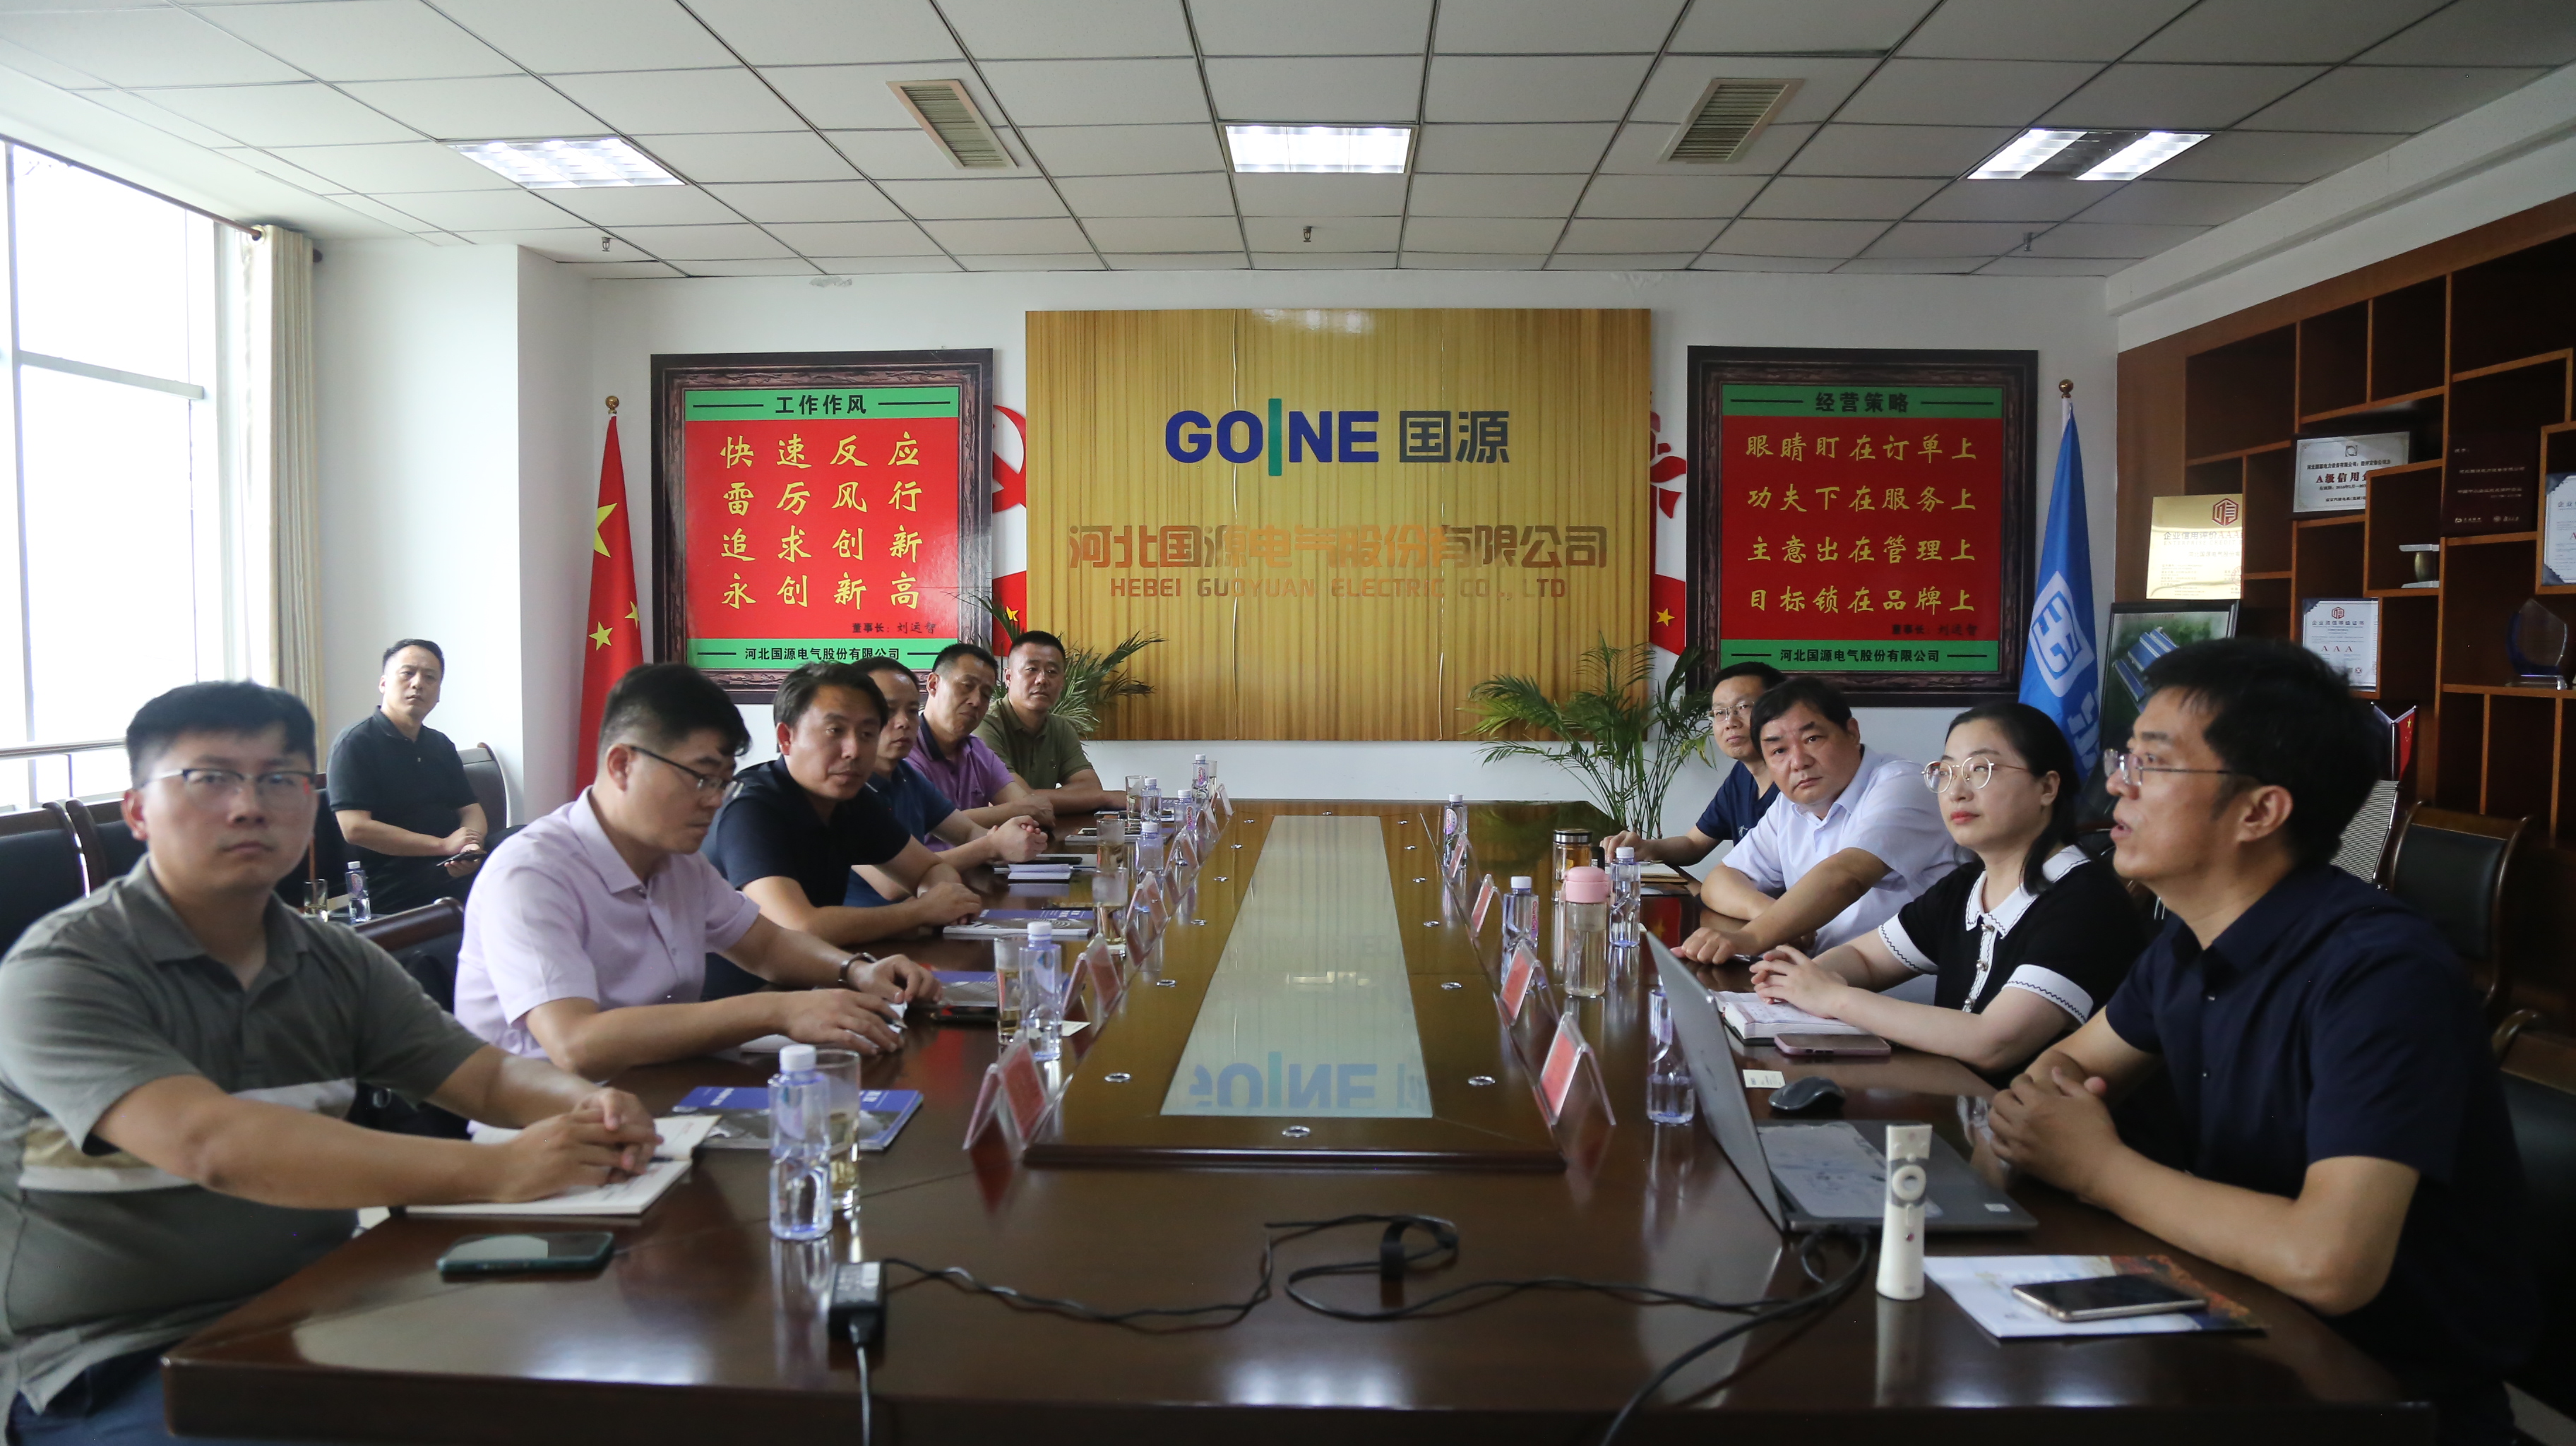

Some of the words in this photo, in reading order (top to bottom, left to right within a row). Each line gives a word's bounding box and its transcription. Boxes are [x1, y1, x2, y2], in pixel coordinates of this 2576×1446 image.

[775, 394, 867, 415] 工作作风
[1815, 391, 1909, 413] 经营策略
[720, 431, 919, 469] 快速反应
[1399, 410, 1510, 463] 国源
[1746, 432, 1976, 464] 眼睛盯在订单上
[723, 481, 922, 516] 雷厉风行
[1747, 483, 1976, 513] 功夫下在服务上
[722, 525, 923, 563] 追求创新
[1068, 524, 1608, 568] 河北国源电气股份有限公司
[1747, 534, 1975, 564] 主意出在管理上
[2163, 531, 2242, 540] 企业信用评价AAA
[722, 571, 919, 610] 永创新高
[1111, 578, 1180, 597] HEBEI
[1197, 578, 1315, 598] GUOYUAN
[1331, 578, 1445, 598] ELECTRIC
[1522, 578, 1566, 598] LTD
[1751, 585, 1974, 615] 目标锁在品牌上
[745, 647, 900, 661] 河北国源电气股份有限公司
[1780, 649, 1939, 662] 河北国源电气股份有限公司
